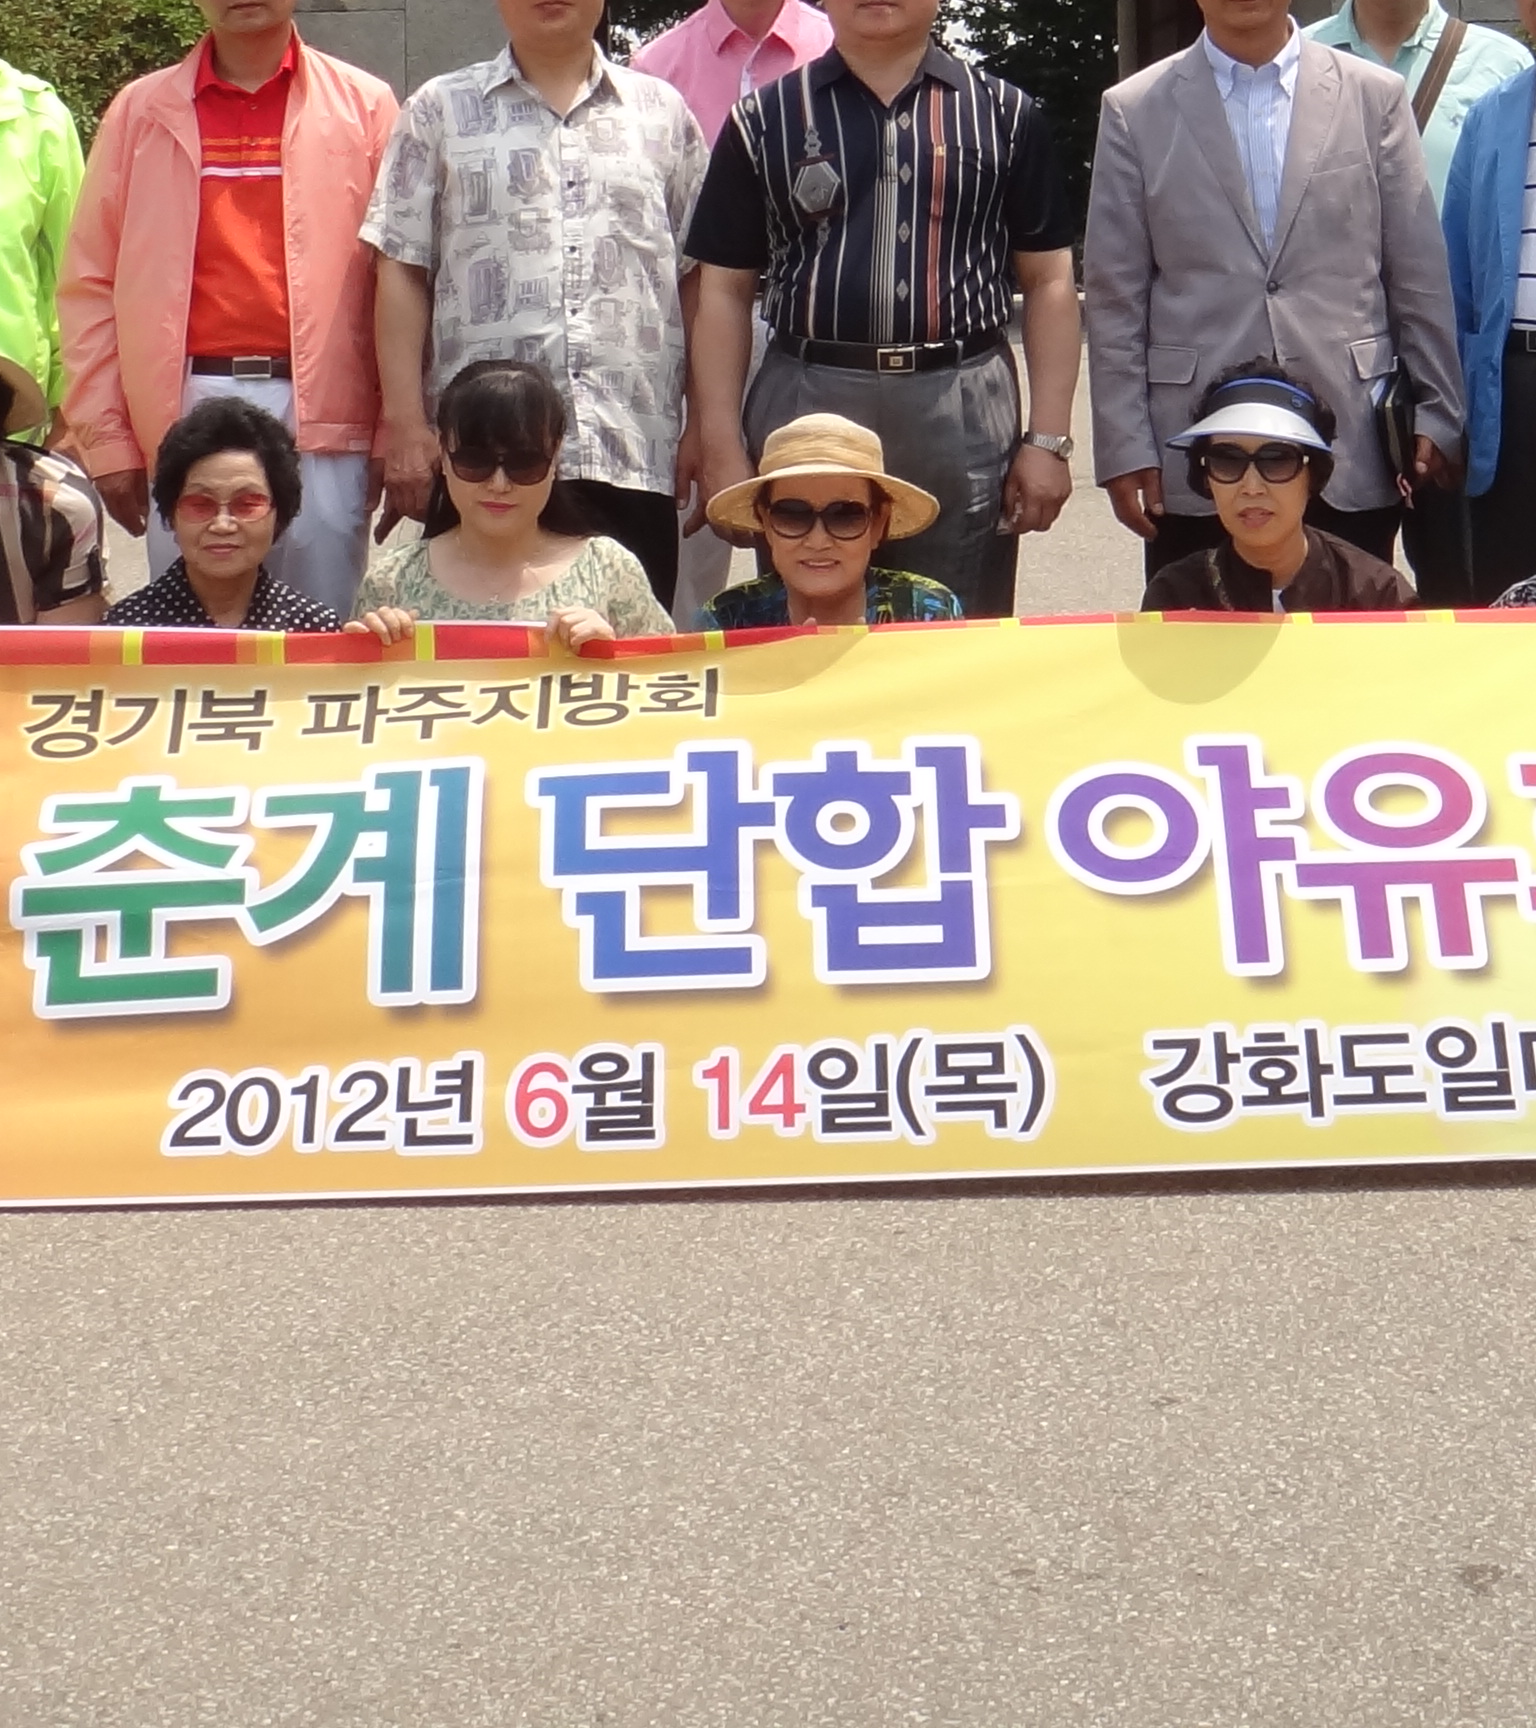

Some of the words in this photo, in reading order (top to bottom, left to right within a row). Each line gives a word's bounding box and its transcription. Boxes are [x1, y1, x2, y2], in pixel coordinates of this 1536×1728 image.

[24, 688, 274, 758] 경기북
[301, 667, 722, 745] 파주지방회
[20, 766, 473, 1001] 춘계
[538, 745, 1008, 980] 단합
[168, 1059, 475, 1148] 2012년
[514, 1051, 656, 1143] 6월
[702, 1033, 1047, 1138] 14일(목)
